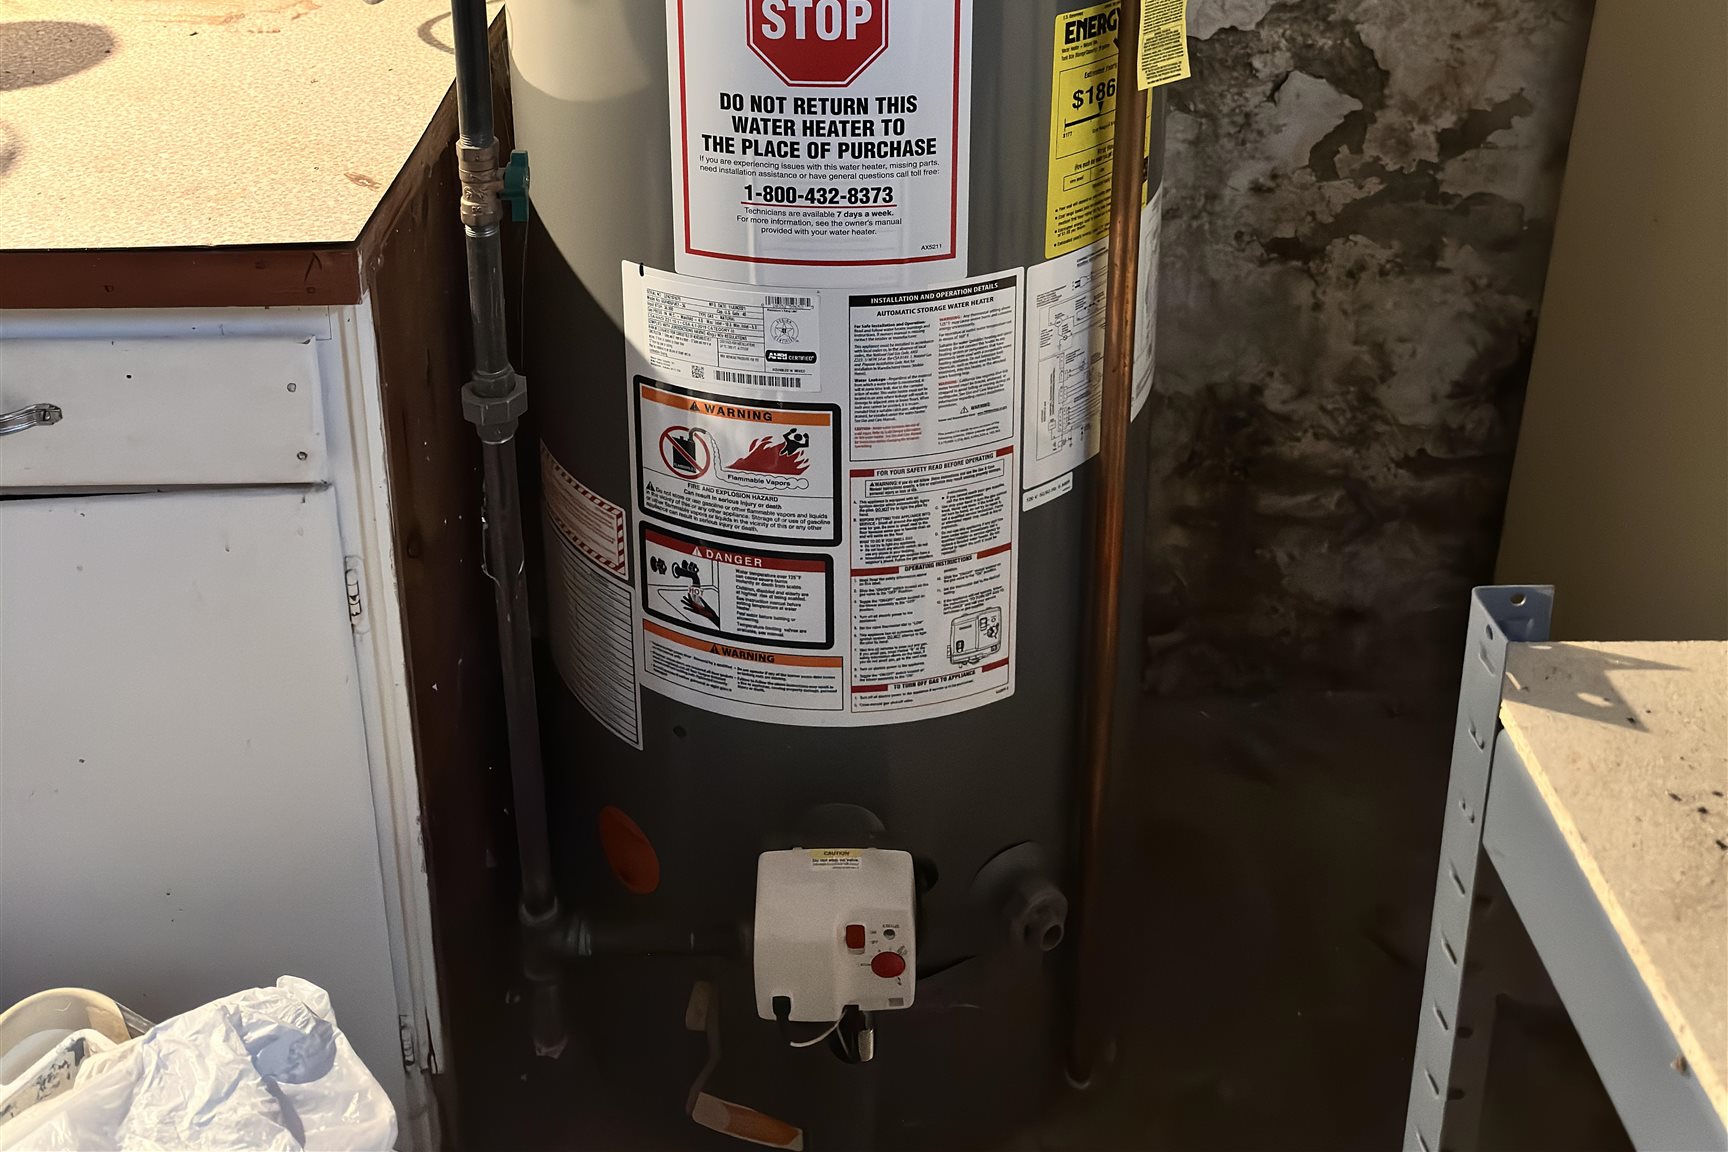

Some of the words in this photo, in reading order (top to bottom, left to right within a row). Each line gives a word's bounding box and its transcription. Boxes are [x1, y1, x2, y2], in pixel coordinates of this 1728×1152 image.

[1072, 78, 1115, 110] $186
[720, 92, 744, 112] DO
[750, 95, 787, 114] NOT
[793, 97, 869, 116] RETURN
[875, 95, 918, 114] THIS
[731, 116, 796, 137] WATER
[802, 119, 875, 138] HEATER
[881, 118, 905, 136] TO
[702, 134, 735, 155] THE
[741, 138, 801, 159] PLACE
[806, 142, 831, 159] OF
[838, 138, 937, 159] PURCHASE
[700, 165, 718, 173] need
[719, 167, 757, 176] installation
[758, 170, 797, 179] assistance
[808, 172, 827, 180] have
[829, 172, 857, 181] general
[858, 171, 894, 181] questions
[896, 170, 909, 178] call
[706, 157, 719, 165] you
[733, 159, 779, 170] experiencing
[781, 162, 805, 170] issues
[807, 163, 822, 171] with
[890, 162, 918, 171] missing
[744, 184, 894, 205] 1-800-432-8373
[736, 214, 749, 223] For
[744, 207, 787, 217] Technicians
[802, 210, 835, 218] available
[843, 210, 862, 220] days
[761, 227, 793, 235] provided
[811, 229, 828, 237] your
[871, 295, 919, 304] INSTALLATION
[935, 288, 973, 299] OPERATION
[973, 282, 999, 293] DETAILS
[877, 308, 916, 317] AUTOMATIC
[917, 305, 947, 314] STORAGE
[947, 301, 970, 309] WATER
[970, 296, 994, 306] HEATER
[705, 403, 773, 421] WARNING
[890, 468, 906, 476] YOUR
[906, 466, 927, 474] SAFETY
[943, 460, 964, 468] BEFORE
[965, 453, 994, 465] OPERATING
[727, 474, 765, 485] Flammable
[765, 478, 791, 487] Vapors
[687, 482, 700, 490] FIRE
[716, 489, 751, 500] EXPLOSION
[752, 494, 778, 502] HAZARD
[706, 549, 762, 567] DANGER
[904, 562, 935, 572] OPERATING
[935, 554, 973, 567] INSTRUCTIONS
[689, 587, 704, 596] HOT
[721, 647, 775, 663] WARNING
[948, 670, 975, 681] APPLIANCE
